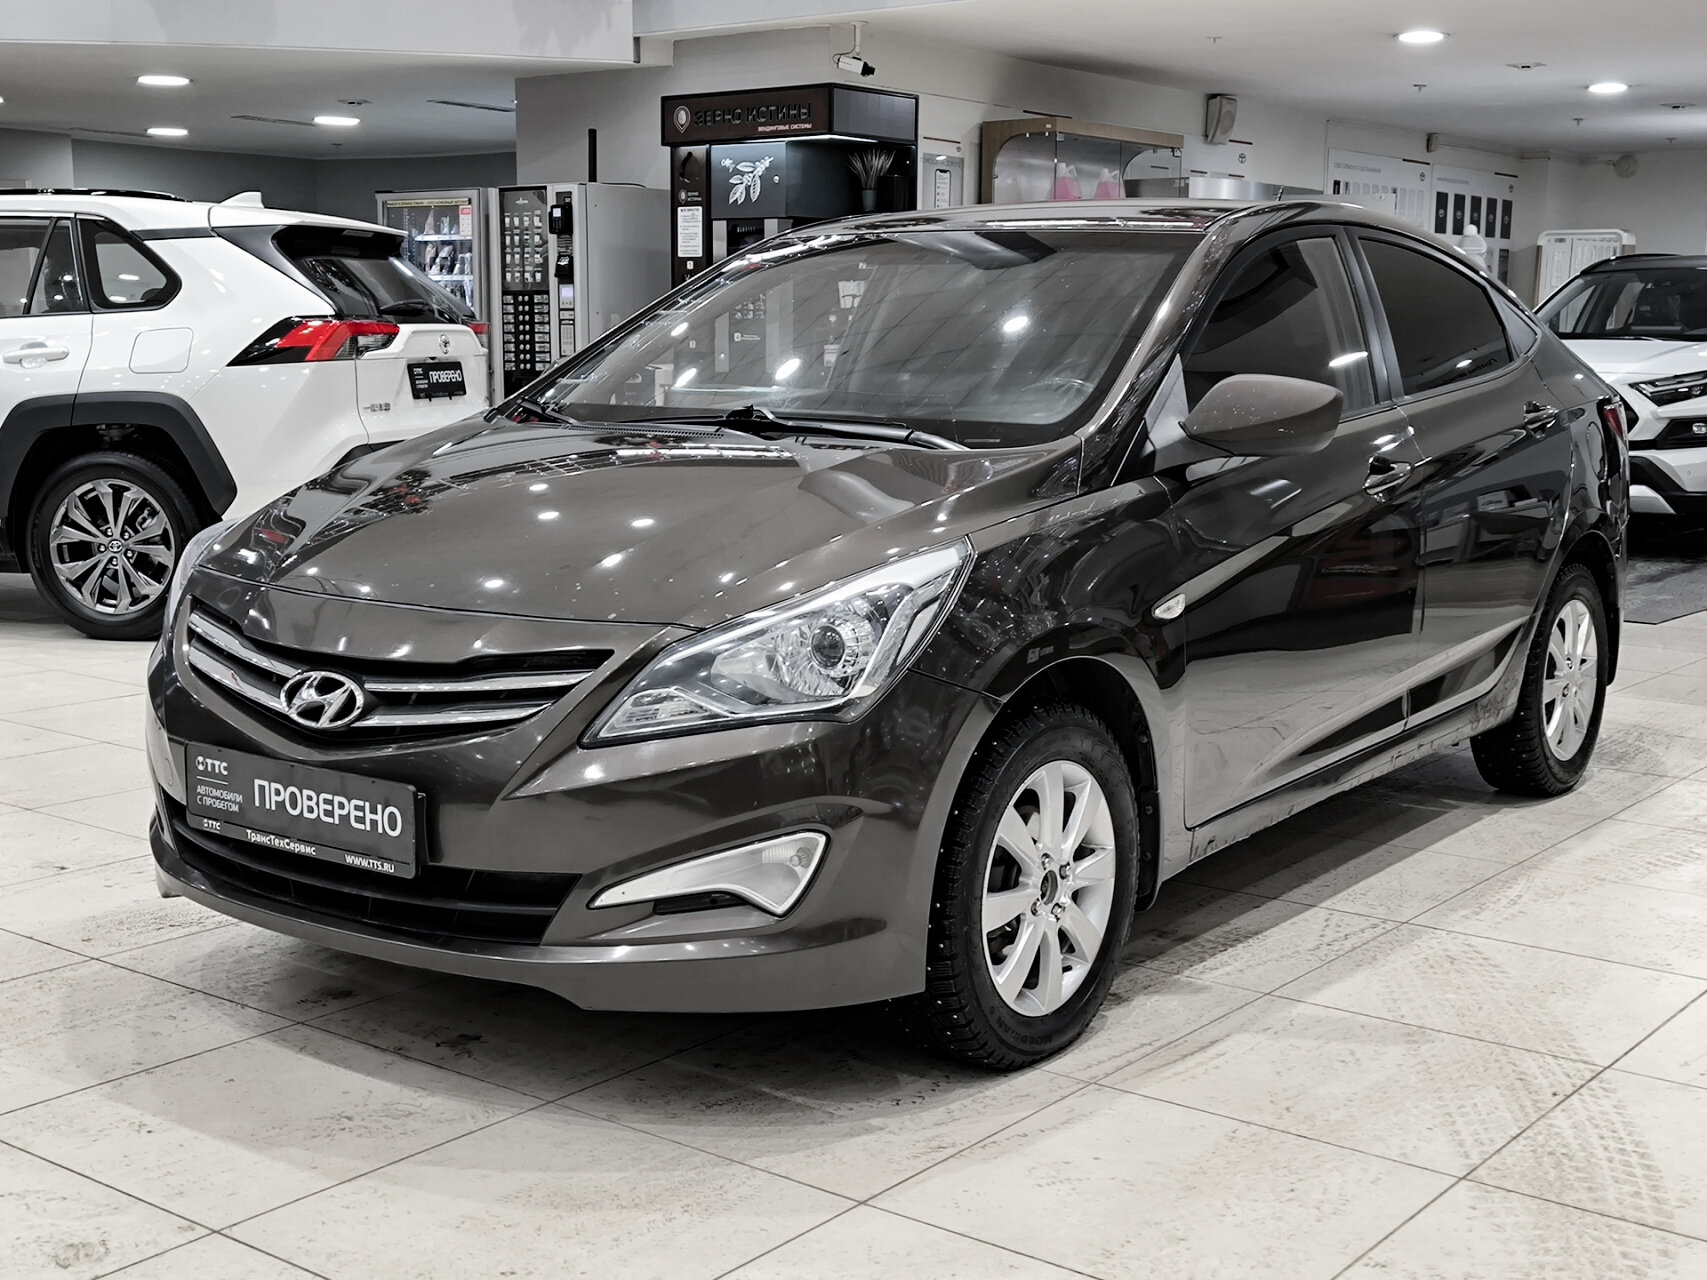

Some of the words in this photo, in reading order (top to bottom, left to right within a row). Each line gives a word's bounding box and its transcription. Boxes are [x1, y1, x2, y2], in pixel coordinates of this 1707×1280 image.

[694, 107, 742, 127] ЗЕРНО
[746, 102, 812, 123] ИСТИНЫ
[429, 369, 463, 383] ПРОВЕРЕНО
[196, 785, 243, 803] АВТОМОБИЛИ
[196, 796, 202, 804] С
[203, 797, 240, 813] ПРОБЕГОМ
[254, 778, 402, 837] ПРОВЕРЕНО
[246, 829, 316, 855] ТрансТехСервис
[345, 854, 395, 873] WWW.TTS.RU
